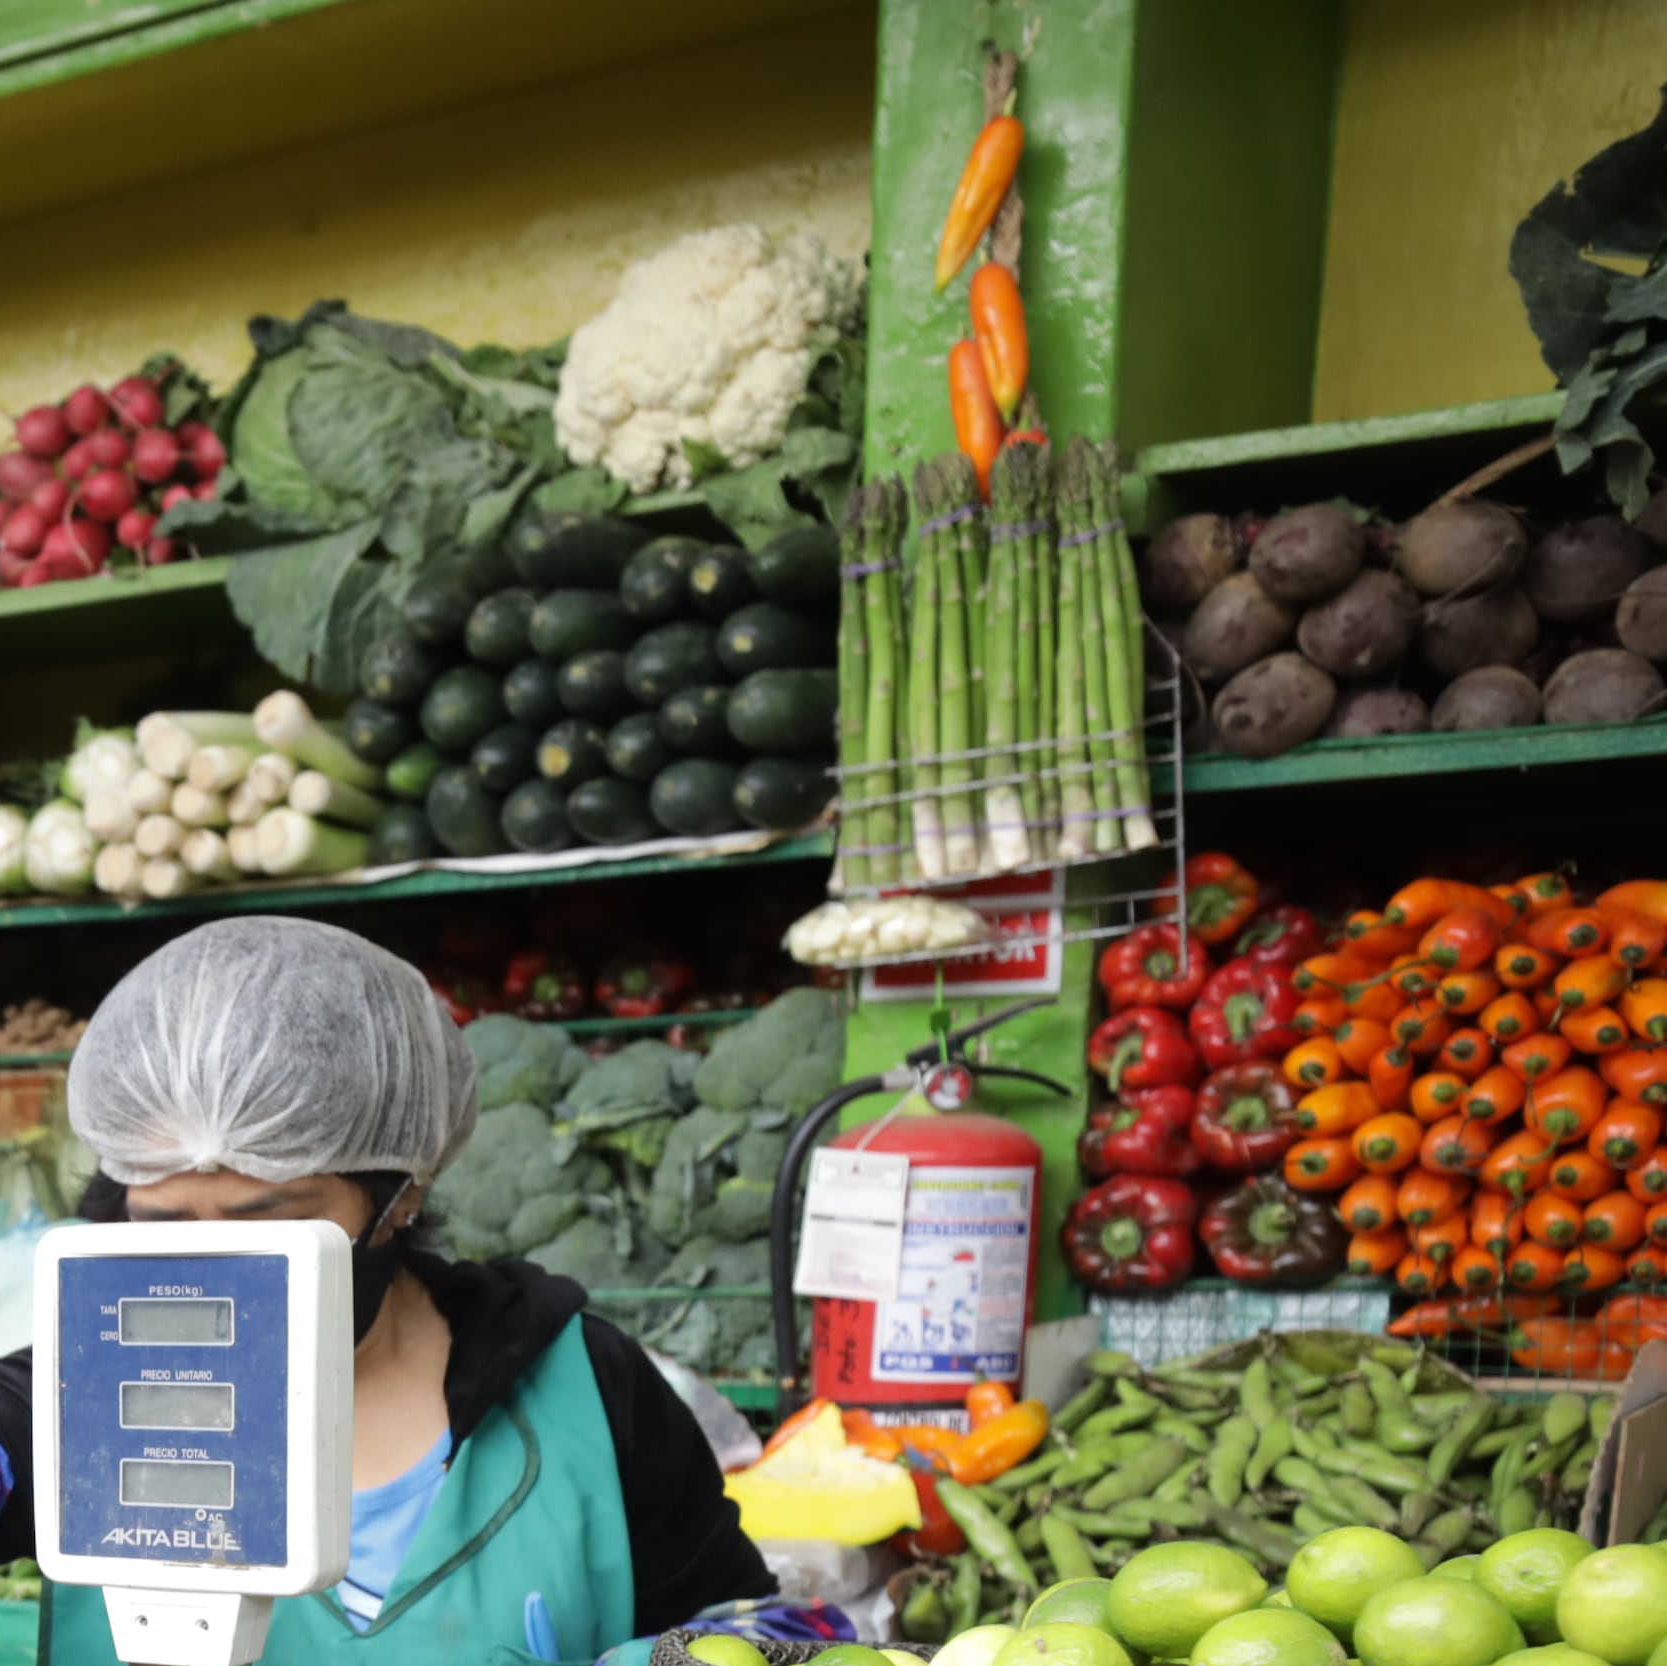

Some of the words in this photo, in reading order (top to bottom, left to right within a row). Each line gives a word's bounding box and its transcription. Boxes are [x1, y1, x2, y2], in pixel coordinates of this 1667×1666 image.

[148, 1285, 203, 1297] PESO(kg)
[99, 1305, 118, 1316] TARA
[99, 1331, 119, 1342] CERO
[140, 1369, 171, 1381] PRECIO
[174, 1369, 213, 1382] UNITARIO
[143, 1446, 178, 1459] PRECIO
[180, 1447, 210, 1460] TOTAL
